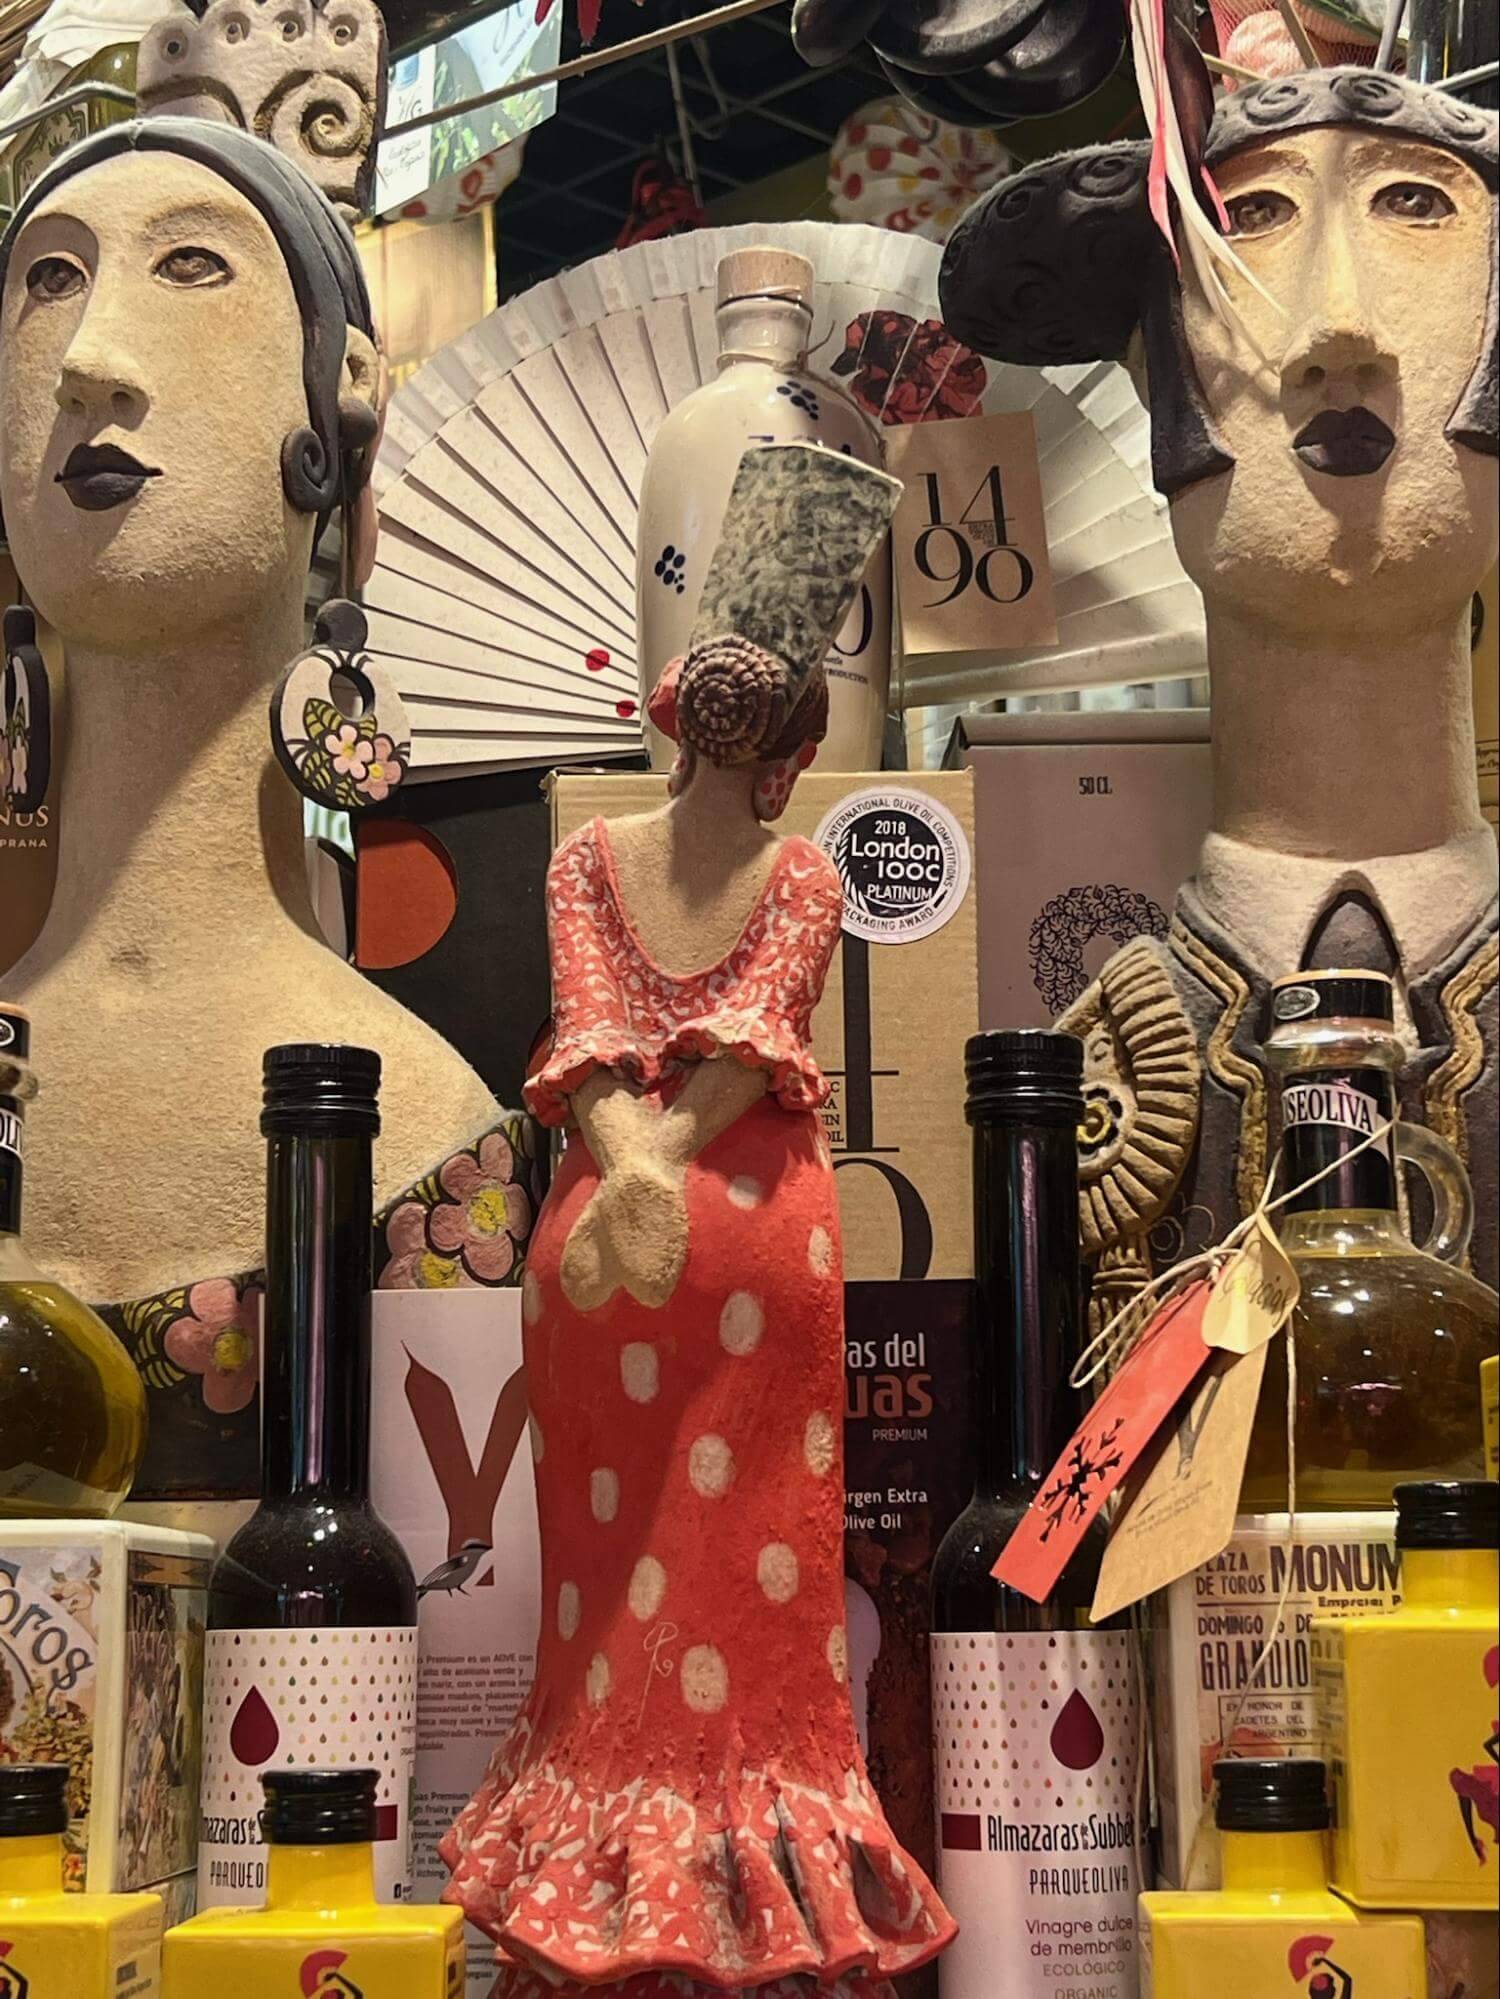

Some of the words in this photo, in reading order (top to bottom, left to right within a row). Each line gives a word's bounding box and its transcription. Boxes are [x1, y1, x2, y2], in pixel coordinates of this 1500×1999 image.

[917, 465, 1018, 547] 14
[914, 527, 1034, 608] 90
[1079, 776, 1094, 795] 50
[874, 820, 907, 836] 2018
[826, 798, 890, 841] INTERNATIONAL
[893, 798, 920, 813] OLIVE
[920, 809, 933, 823] OIL
[932, 821, 957, 888] COMPETITIONS
[851, 833, 940, 862] London
[867, 883, 933, 902] PLATINUM
[898, 907, 935, 931] AWARD
[844, 1341, 876, 1368] as
[885, 1333, 926, 1367] del
[872, 1429, 927, 1441] PREMIUM
[887, 1488, 928, 1503] Extra
[880, 1513, 902, 1529] Oil
[1195, 1552, 1249, 1572] LAZA
[1195, 1575, 1214, 1595] DE
[1221, 1575, 1266, 1595] TOROS
[1198, 1615, 1264, 1636] DOMINGO
[987, 1814, 1079, 1851] Almazaras
[210, 1861, 265, 1889] PARQUEO
[1029, 1865, 1129, 1896] PARQUEOLIVA
[1026, 1919, 1093, 1938] Vinagre
[1098, 1915, 1133, 1932] dulce
[1030, 1940, 1052, 1956] de
[1058, 1938, 1132, 1955] membrillo
[1043, 1959, 1126, 1976] ECOLÓGICO
[1055, 1985, 1118, 1999] ORGANIC
